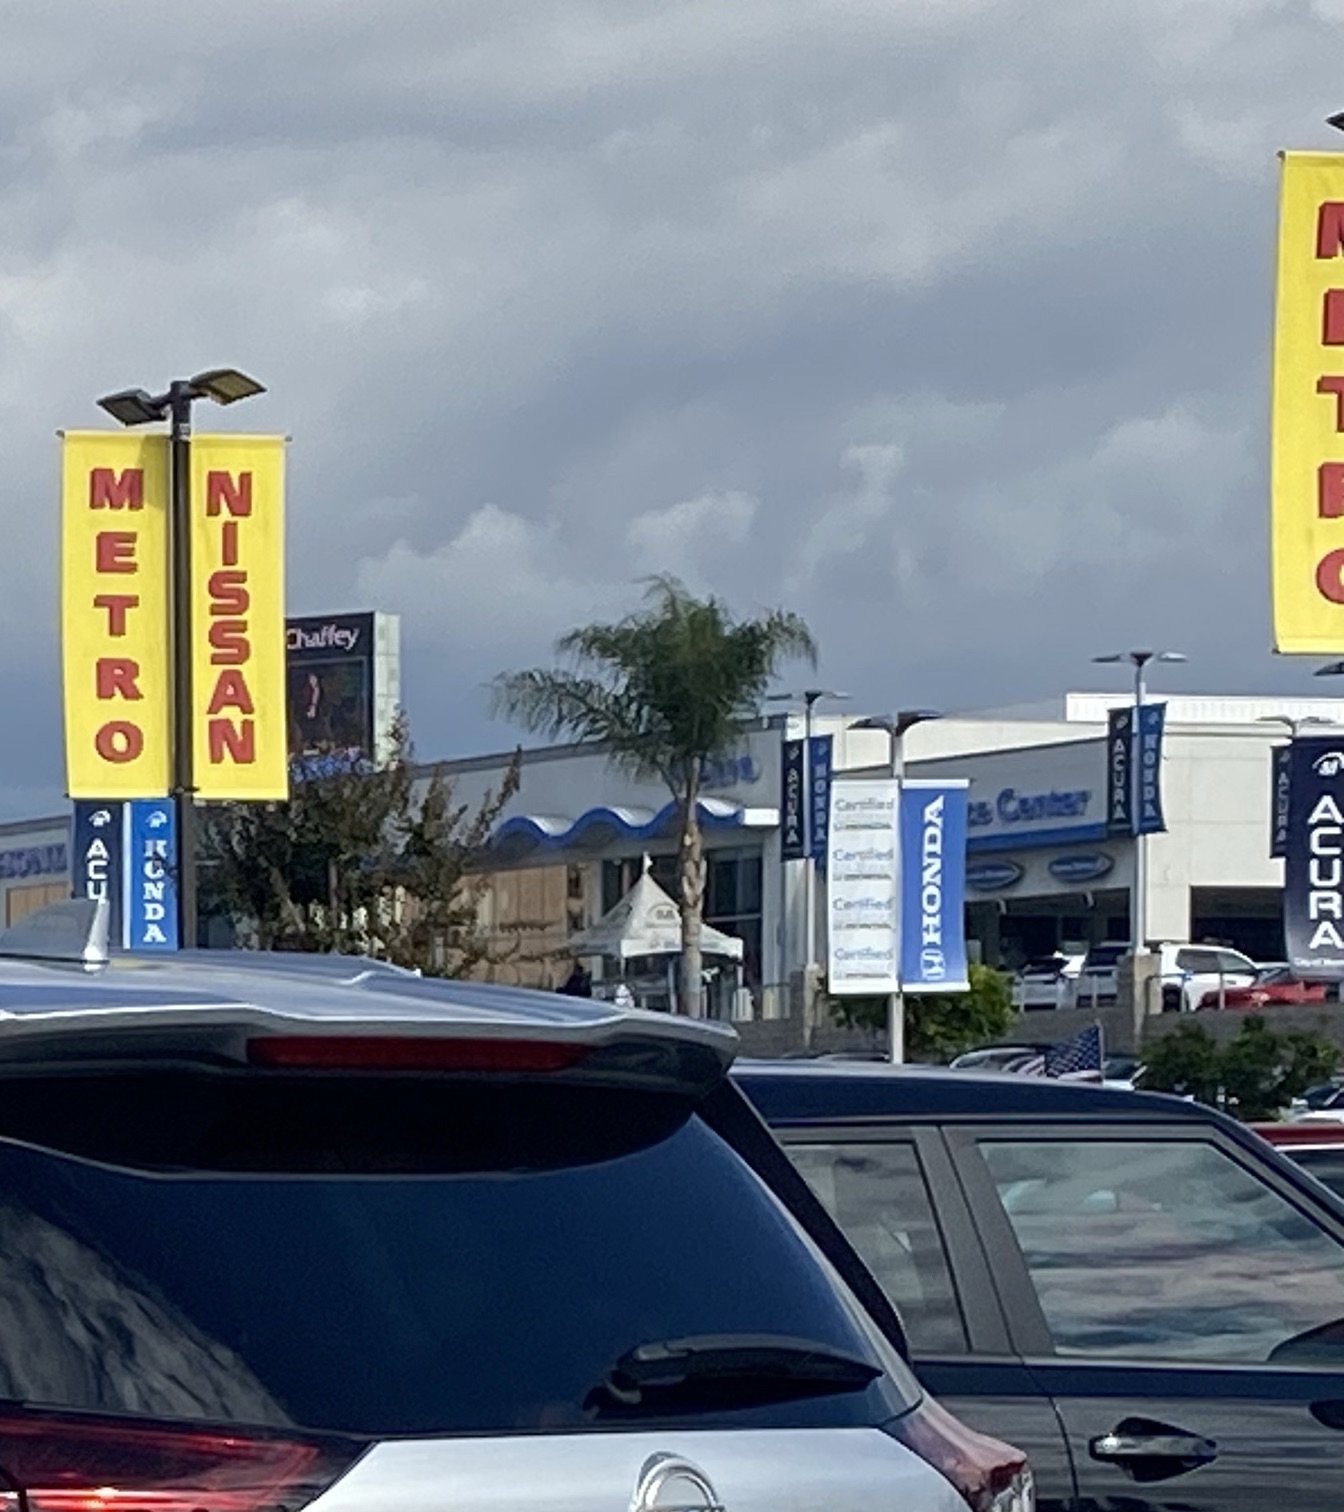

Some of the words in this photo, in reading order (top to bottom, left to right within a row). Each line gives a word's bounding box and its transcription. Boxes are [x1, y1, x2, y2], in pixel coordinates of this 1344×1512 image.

[89, 467, 145, 764] METRO
[205, 470, 256, 765] NISSAN
[286, 623, 360, 652] Chaffey
[786, 767, 800, 844] ACURA
[1113, 738, 1127, 819] ACURA
[86, 838, 110, 901] ACU
[922, 794, 945, 946] HONDA
[1307, 794, 1344, 950] ACURA
